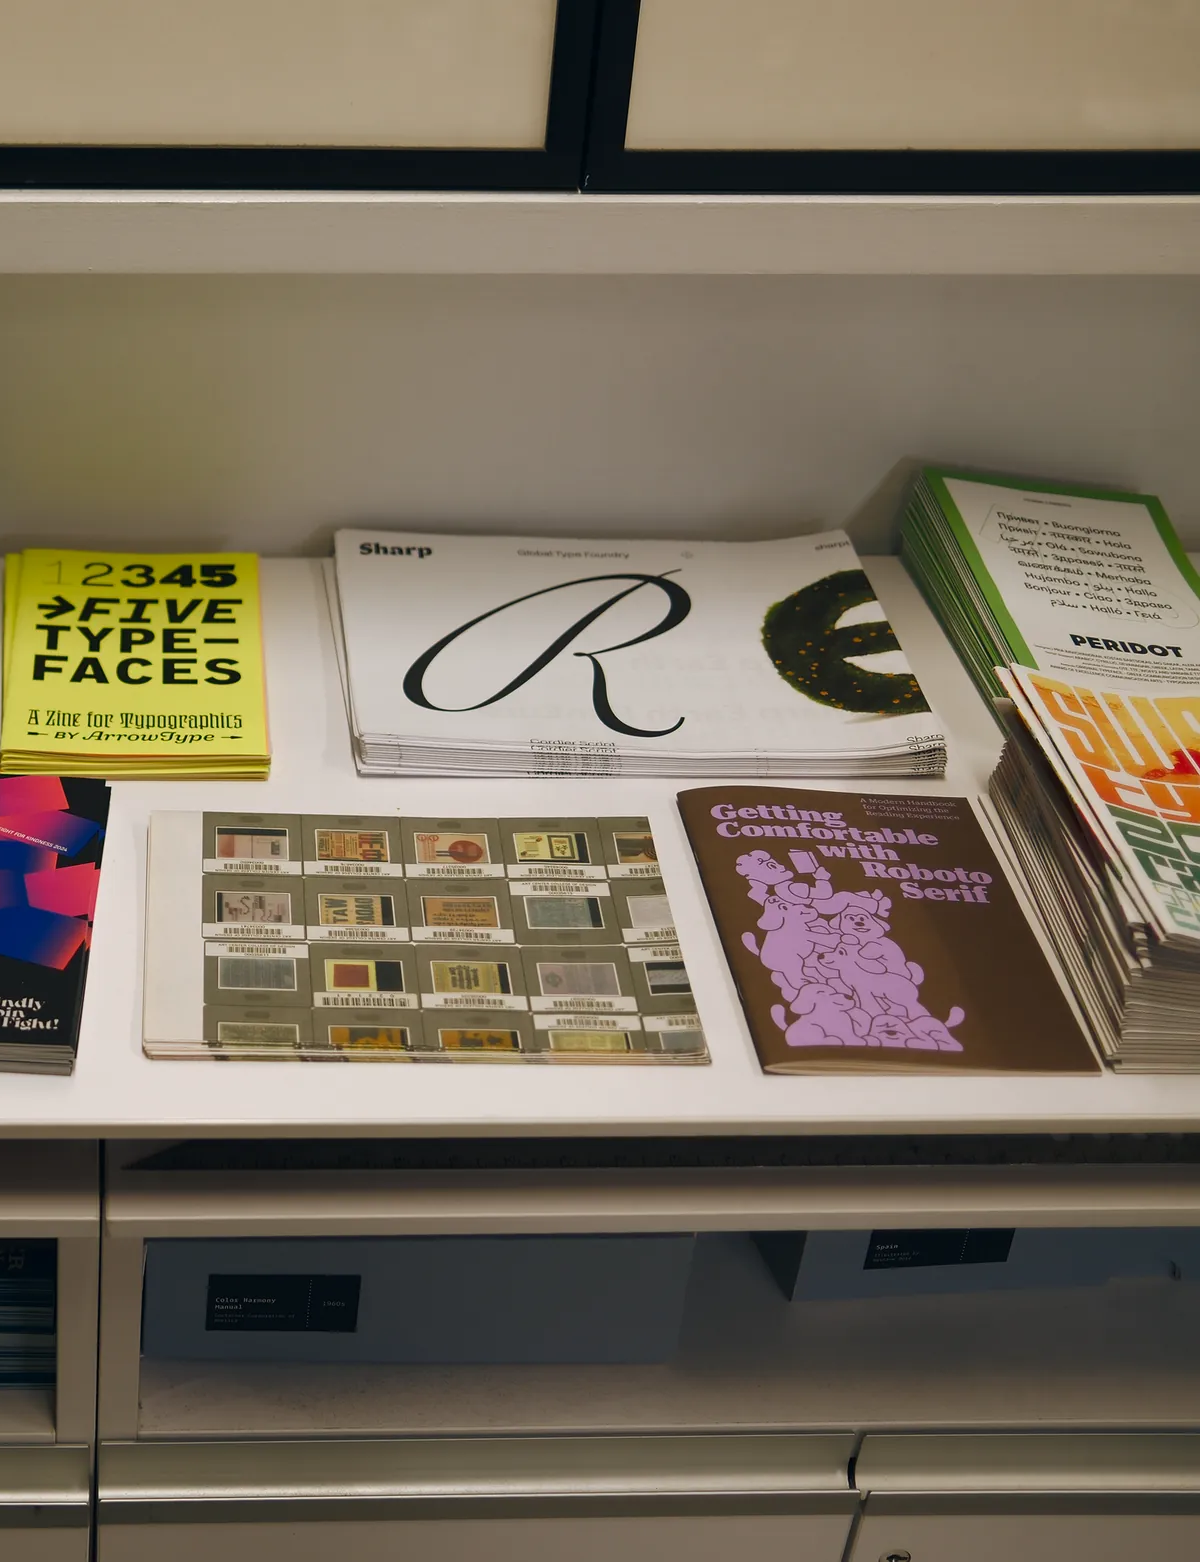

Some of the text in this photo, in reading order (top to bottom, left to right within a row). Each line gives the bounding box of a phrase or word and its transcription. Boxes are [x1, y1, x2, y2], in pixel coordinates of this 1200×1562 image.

[359, 542, 433, 559] Sharp
[1102, 539, 1132, 550] Hola
[517, 549, 630, 559] Global Type Foundry
[1078, 546, 1143, 562] Sawubona
[1025, 571, 1081, 586] Hujambo
[1095, 571, 1152, 585] Merhaba
[1024, 581, 1071, 596] Bonjour
[1124, 586, 1158, 597] Hallo
[1083, 591, 1113, 602] Ciao
[78, 597, 243, 624] FIVE
[403, 568, 692, 738] R
[1069, 634, 1183, 659] PERIDOT
[32, 655, 242, 685] FACES
[27, 708, 243, 730] A Zine for Typographics
[54, 731, 215, 744] BY ArrowType
[878, 804, 932, 814] Optimizing
[906, 799, 957, 807] Handbook
[710, 802, 847, 829] Getting
[865, 810, 960, 821] Reading Experience
[716, 821, 939, 847] Comfortable
[816, 842, 901, 861] with
[859, 861, 993, 885] Roboto
[899, 881, 991, 904] Serif
[2, 1016, 60, 1031] Fight!
[215, 1296, 277, 1305] Color Harmony
